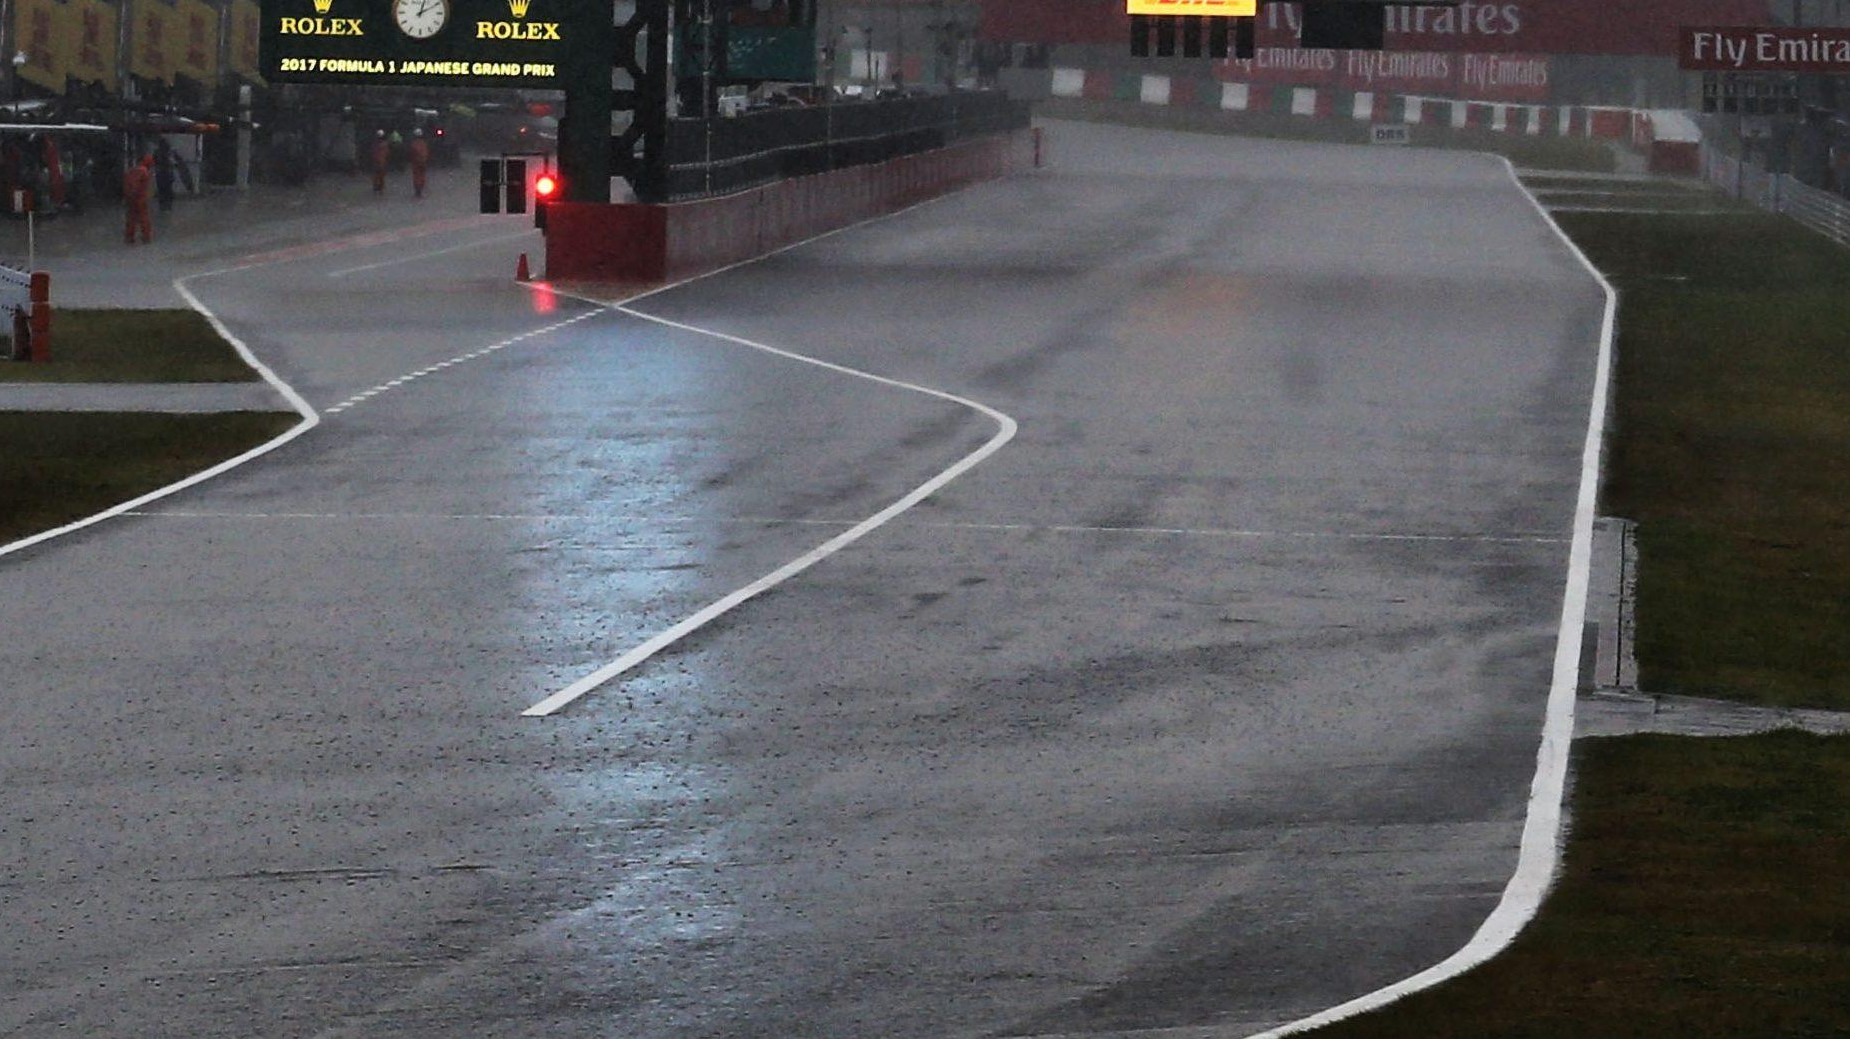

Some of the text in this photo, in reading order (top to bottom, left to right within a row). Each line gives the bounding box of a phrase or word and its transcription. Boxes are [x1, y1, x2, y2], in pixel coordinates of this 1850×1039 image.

[280, 17, 364, 36] ROLEX
[476, 21, 561, 40] ROLEX
[1693, 33, 1747, 67] Fly
[280, 58, 555, 78] 2017 FORMULA 1 JAPANESE GRAND PRIX
[1462, 53, 1547, 90] Fly Emirates
